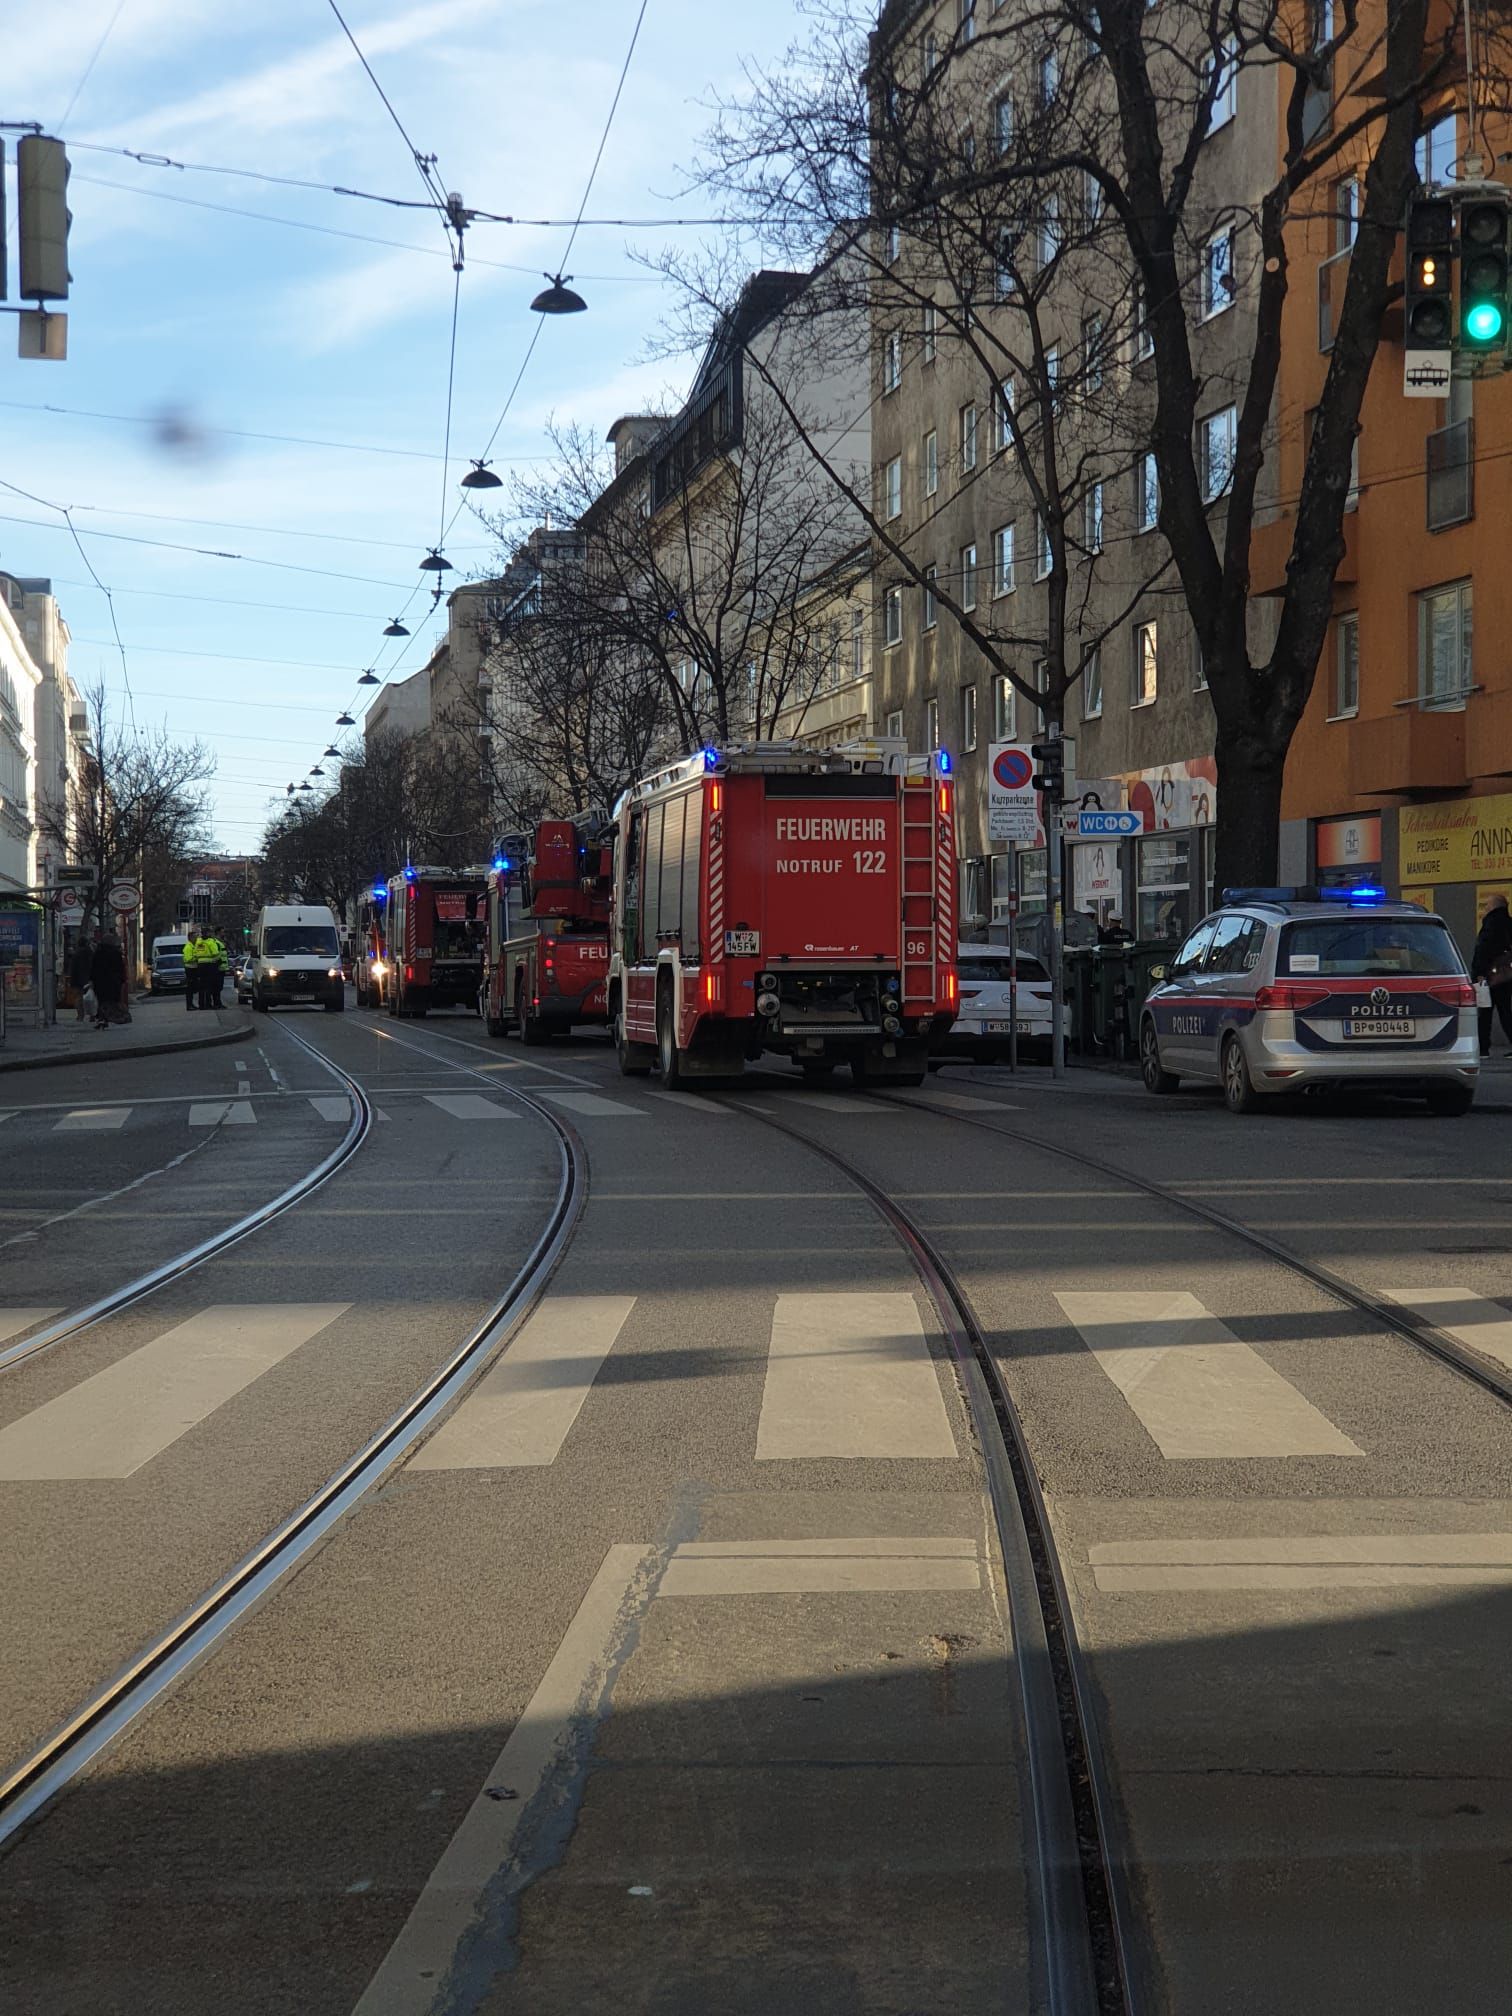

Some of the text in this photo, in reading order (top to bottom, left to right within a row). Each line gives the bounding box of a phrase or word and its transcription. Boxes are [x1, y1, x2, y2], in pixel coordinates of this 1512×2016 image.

[992, 793, 1034, 806] Kurzparkzone
[776, 818, 886, 840] FEUERWEHR
[1082, 816, 1104, 830] WC
[776, 850, 886, 873] NOTRUF 122
[735, 933, 754, 941] W 2
[907, 941, 926, 955] 96
[1351, 1005, 1410, 1016] POLIZEI
[1172, 1016, 1202, 1034] POLIZEI
[1354, 1022, 1410, 1033] BP 90448
